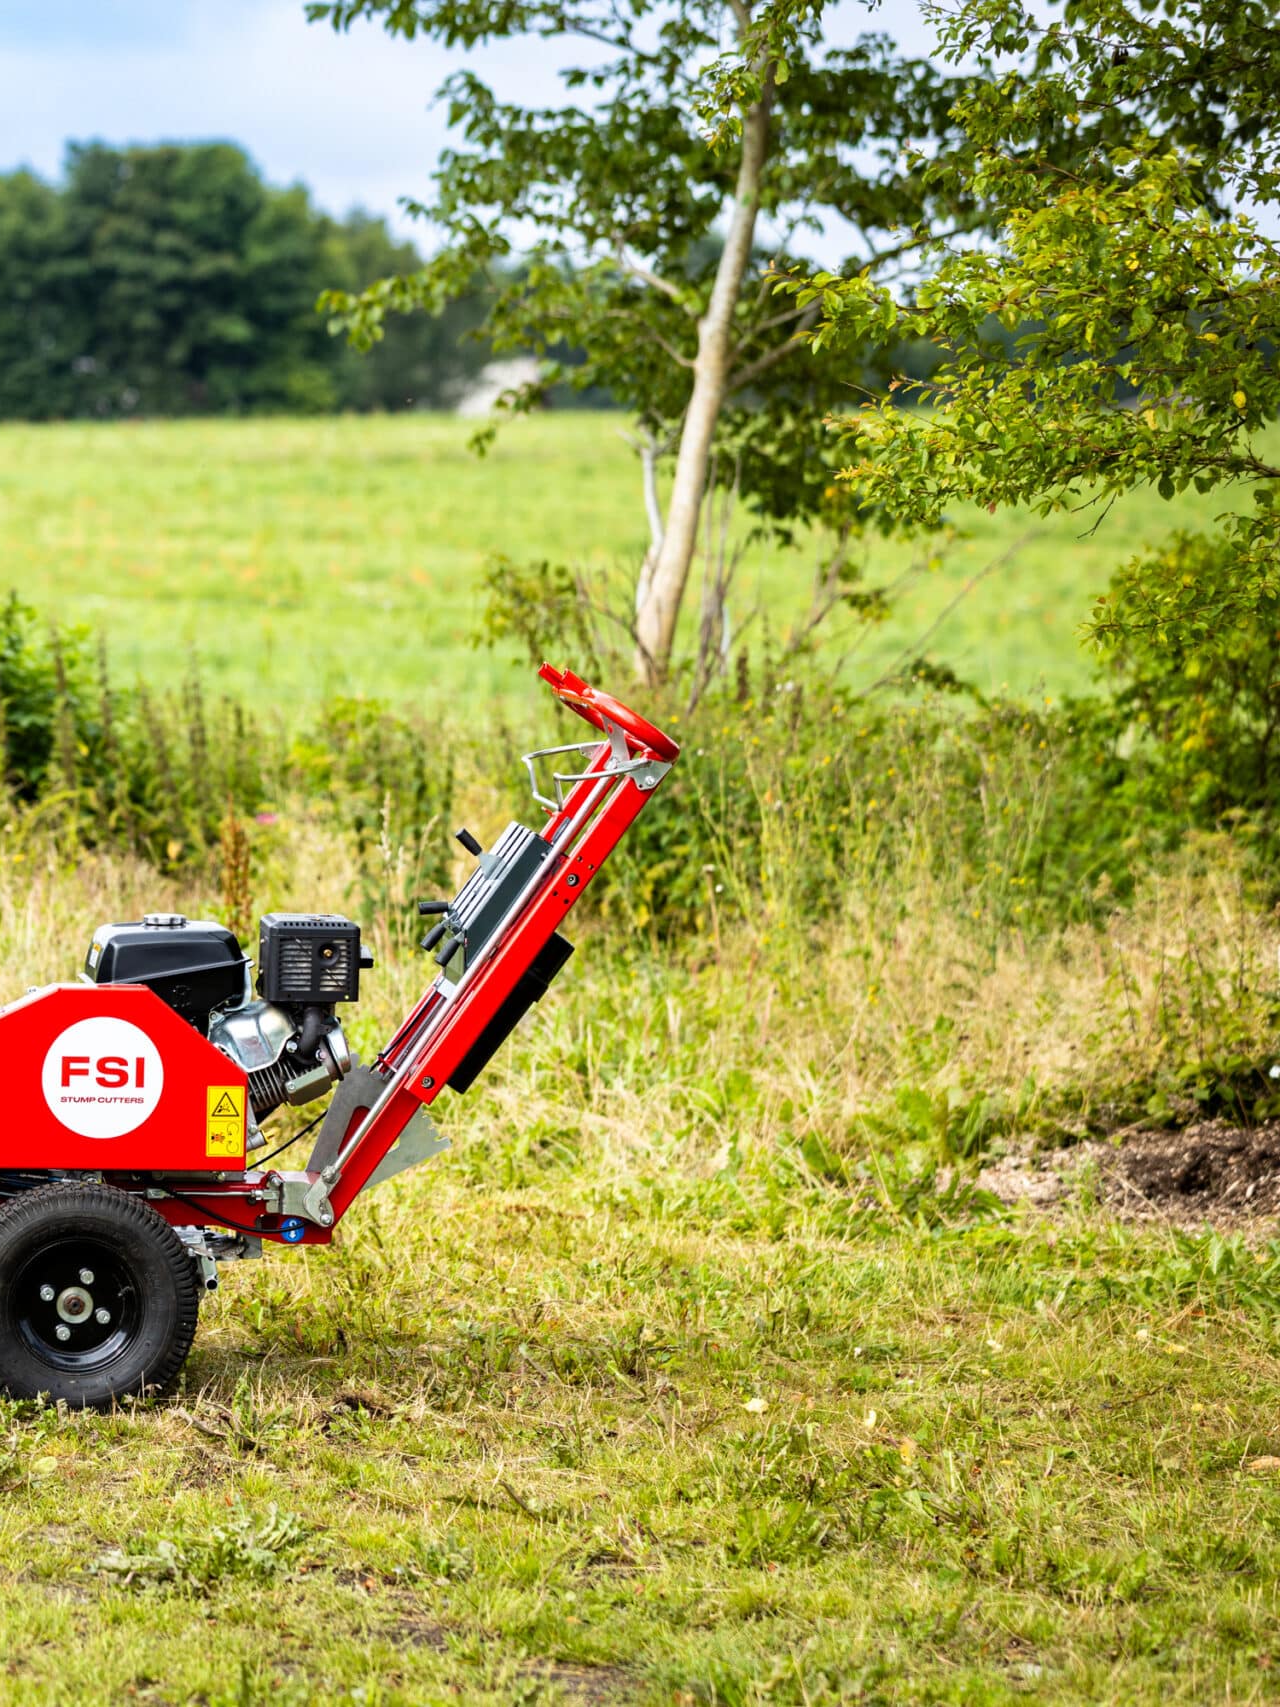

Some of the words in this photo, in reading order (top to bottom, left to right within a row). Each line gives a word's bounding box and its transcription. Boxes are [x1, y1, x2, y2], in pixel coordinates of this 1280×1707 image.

[60, 1055, 145, 1089] FSI
[60, 1096, 96, 1104] STUMP
[97, 1096, 145, 1105] CUTTERS
